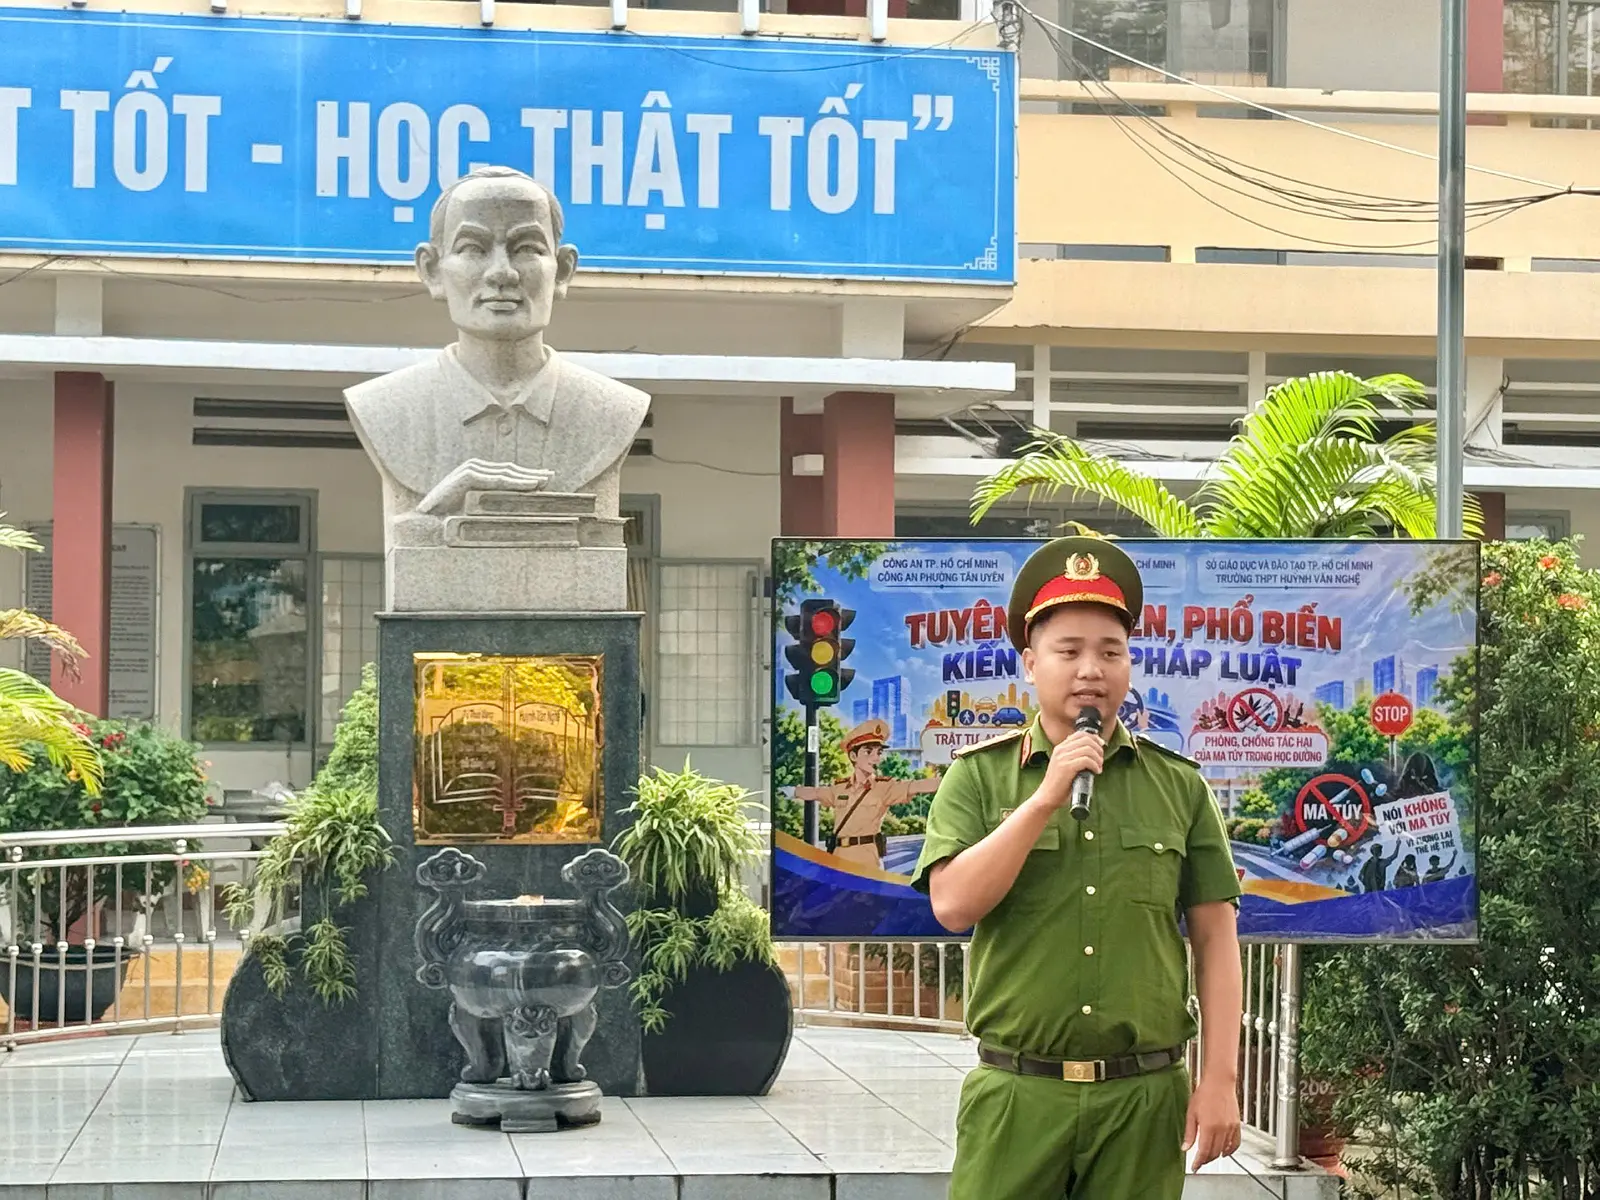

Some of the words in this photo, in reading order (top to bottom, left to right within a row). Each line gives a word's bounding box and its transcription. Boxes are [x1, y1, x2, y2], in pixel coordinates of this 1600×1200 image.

[60, 56, 222, 192] TỐT
[316, 100, 490, 223] HỌC
[521, 90, 733, 230] THẬT
[882, 557, 908, 569] CÔNG
[909, 559, 923, 569] AN
[925, 559, 938, 569] TP.
[956, 557, 972, 569] CHÍ
[974, 559, 998, 569] MINH
[1136, 558, 1150, 569] CHÍ
[1152, 560, 1175, 569] MINH
[1219, 558, 1238, 570] GIÁO
[1240, 560, 1257, 572] DỤC
[1259, 559, 1271, 570] VÀ
[1271, 559, 1288, 570] ĐÀO
[1290, 560, 1306, 573] TẠO
[1335, 559, 1350, 570] CHÍ
[1351, 560, 1373, 570] MINH
[877, 570, 903, 582] CÔNG
[905, 572, 918, 582] AN
[920, 571, 959, 582] PHƯỜNG
[980, 571, 1005, 582] UYÊN
[1216, 572, 1253, 584] TRƯỜNG
[1255, 574, 1278, 584] THPT
[1280, 572, 1312, 584] HUỲNH
[1335, 572, 1361, 586] NGHỆ
[1183, 594, 1254, 643] PHỔ
[1262, 602, 1342, 651] BIẾN
[943, 640, 1017, 682] KIẾN
[1220, 647, 1302, 689] LUẬT
[1374, 705, 1409, 722] STOP
[934, 732, 962, 747] TRẬT
[1242, 734, 1274, 748] CHỐNG
[1276, 734, 1294, 748] TÁC
[1194, 748, 1211, 761] CỦA
[1213, 751, 1226, 761] MA
[1245, 751, 1273, 762] TRONG
[1274, 751, 1291, 764] HỌC
[1293, 748, 1322, 762] ĐƯỜNG
[1303, 803, 1328, 820] MA
[1382, 806, 1402, 821] NÓI
[1404, 797, 1447, 817] KHÔNG
[1408, 817, 1428, 831] MA
[1429, 811, 1450, 827] TÚY
